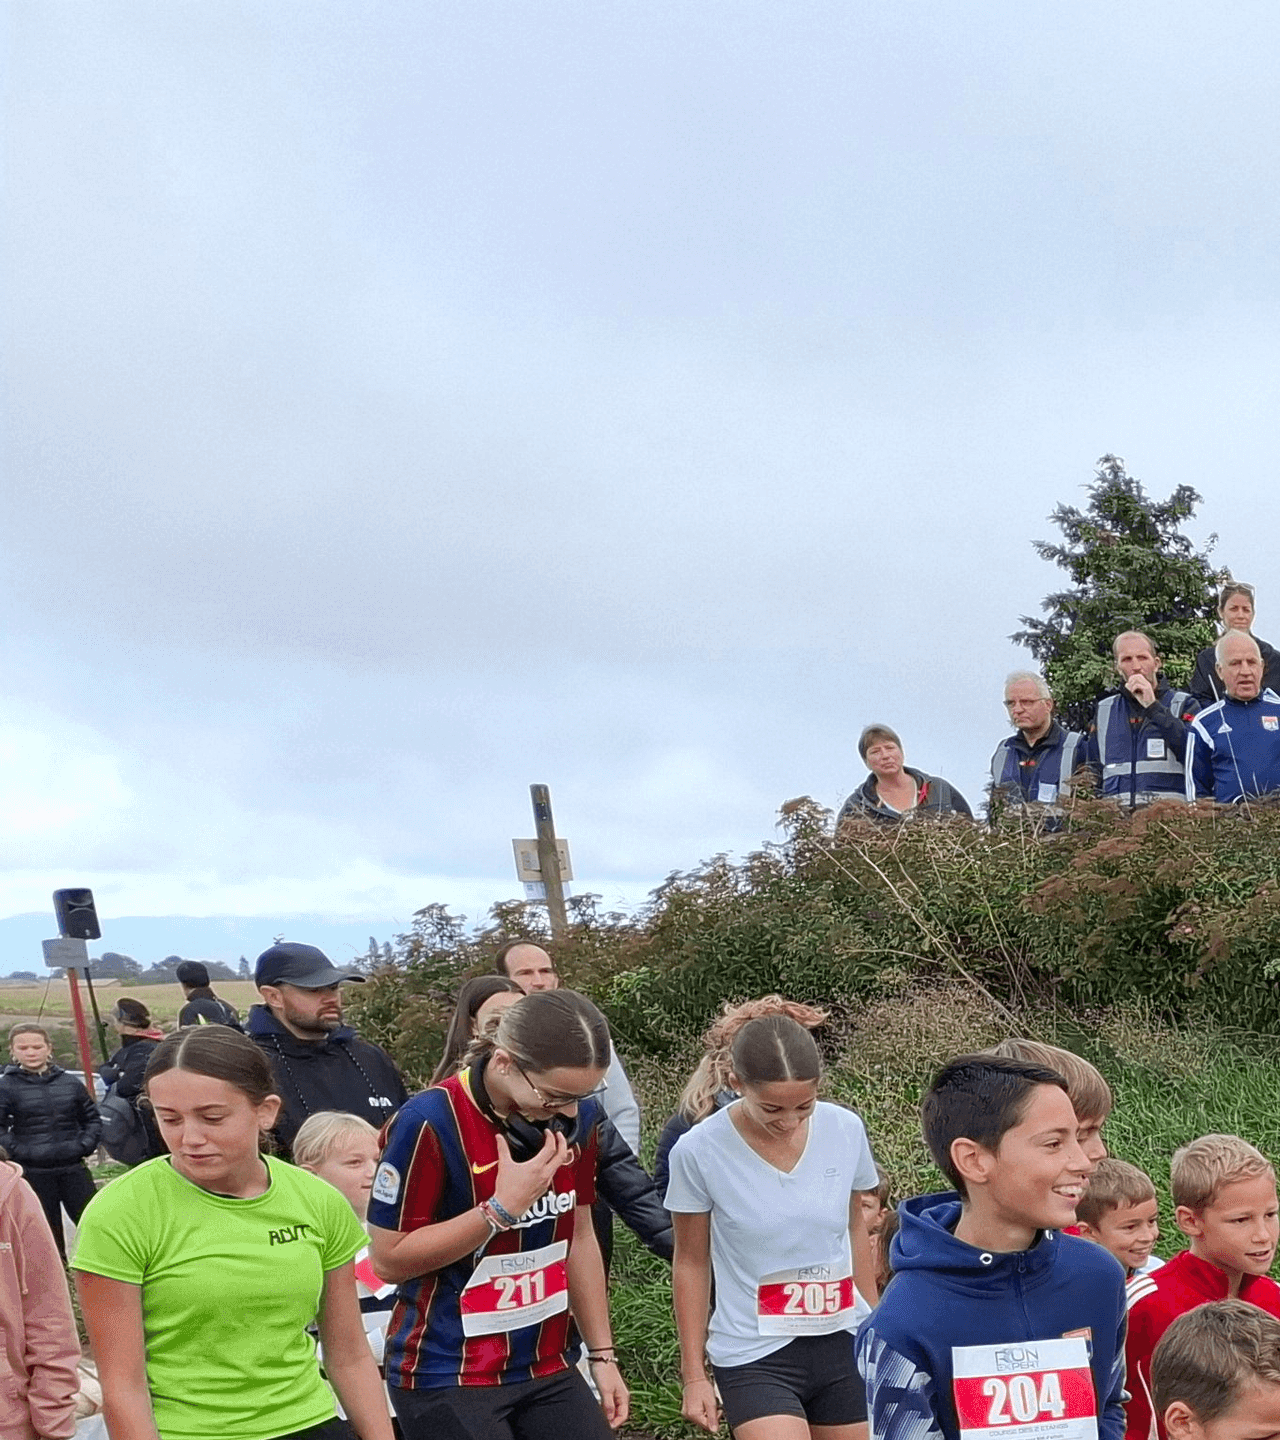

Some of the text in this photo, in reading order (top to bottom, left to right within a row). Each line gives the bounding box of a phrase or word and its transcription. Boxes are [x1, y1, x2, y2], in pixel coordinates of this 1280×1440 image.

[501, 1256, 535, 1270] RUN
[798, 1266, 830, 1277] RUN
[494, 1270, 545, 1310] 211
[783, 1282, 841, 1314] 205
[995, 1347, 1039, 1363] RUN
[982, 1373, 1066, 1424] 204
